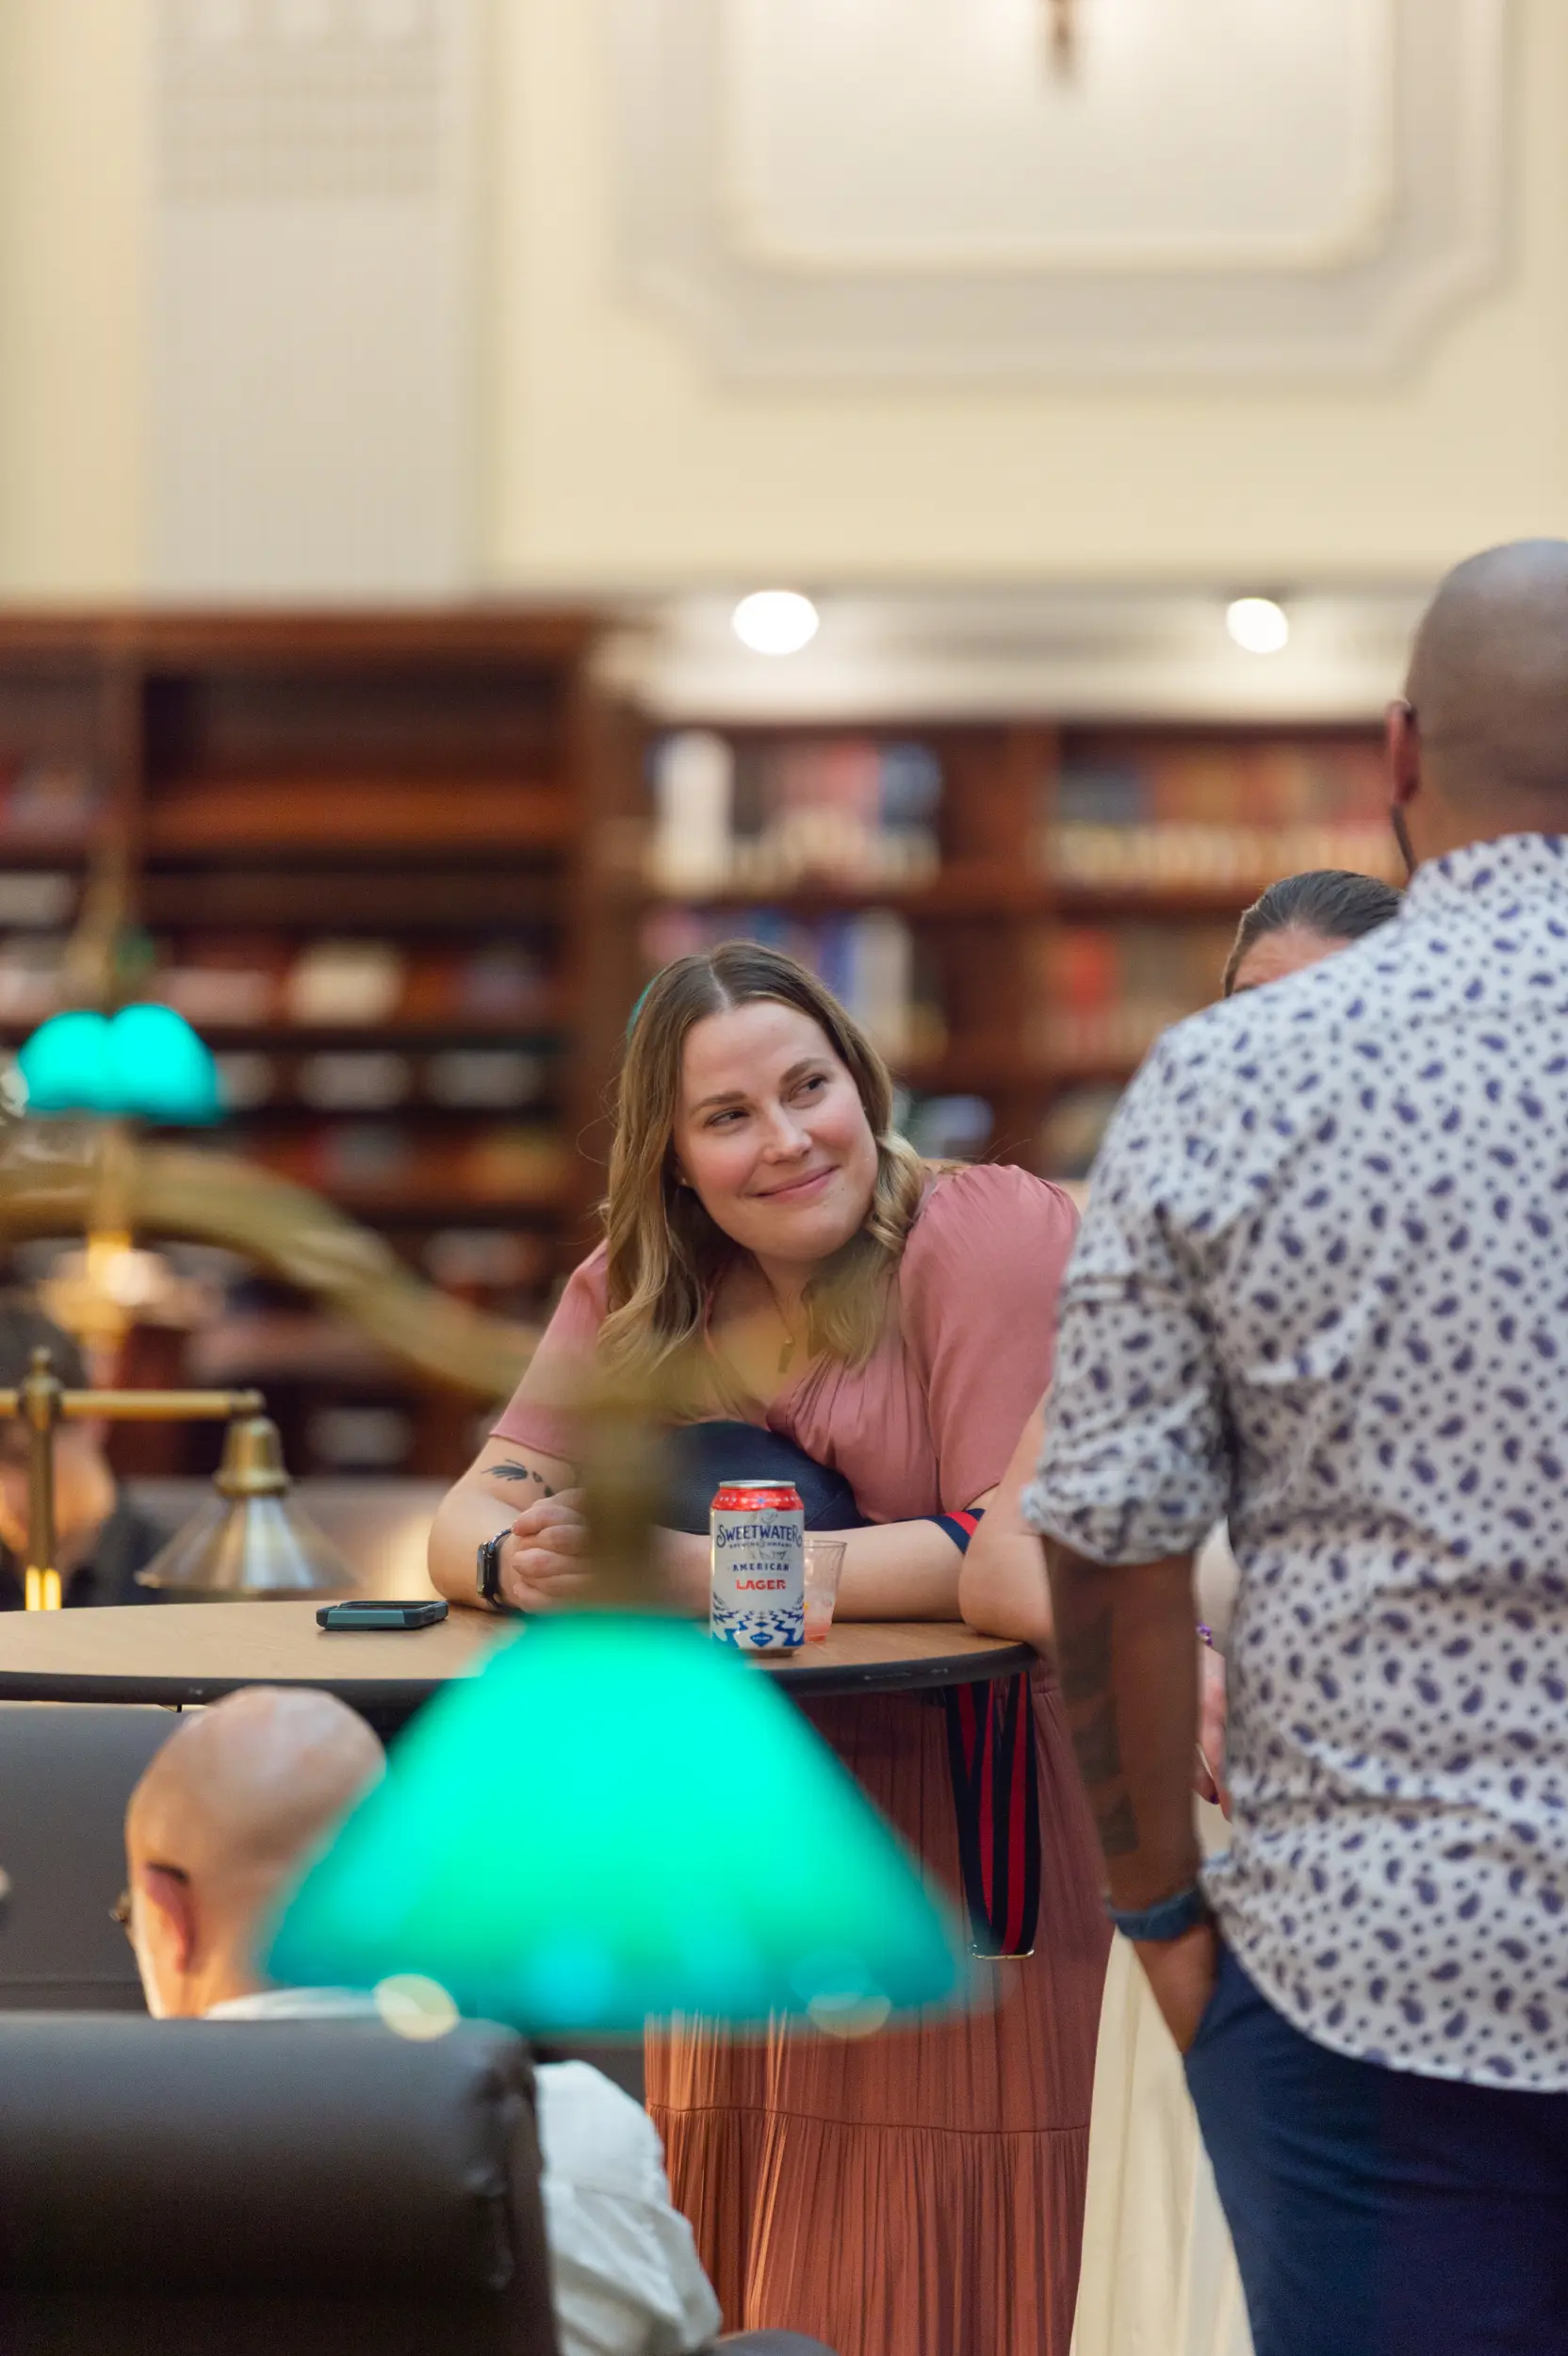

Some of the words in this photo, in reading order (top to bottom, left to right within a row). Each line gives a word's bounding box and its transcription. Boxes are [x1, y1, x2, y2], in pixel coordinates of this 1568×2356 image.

[717, 1524, 802, 1547] SWEETWATER
[732, 1562, 790, 1572] AMERICAN
[736, 1579, 786, 1591] LAGER
